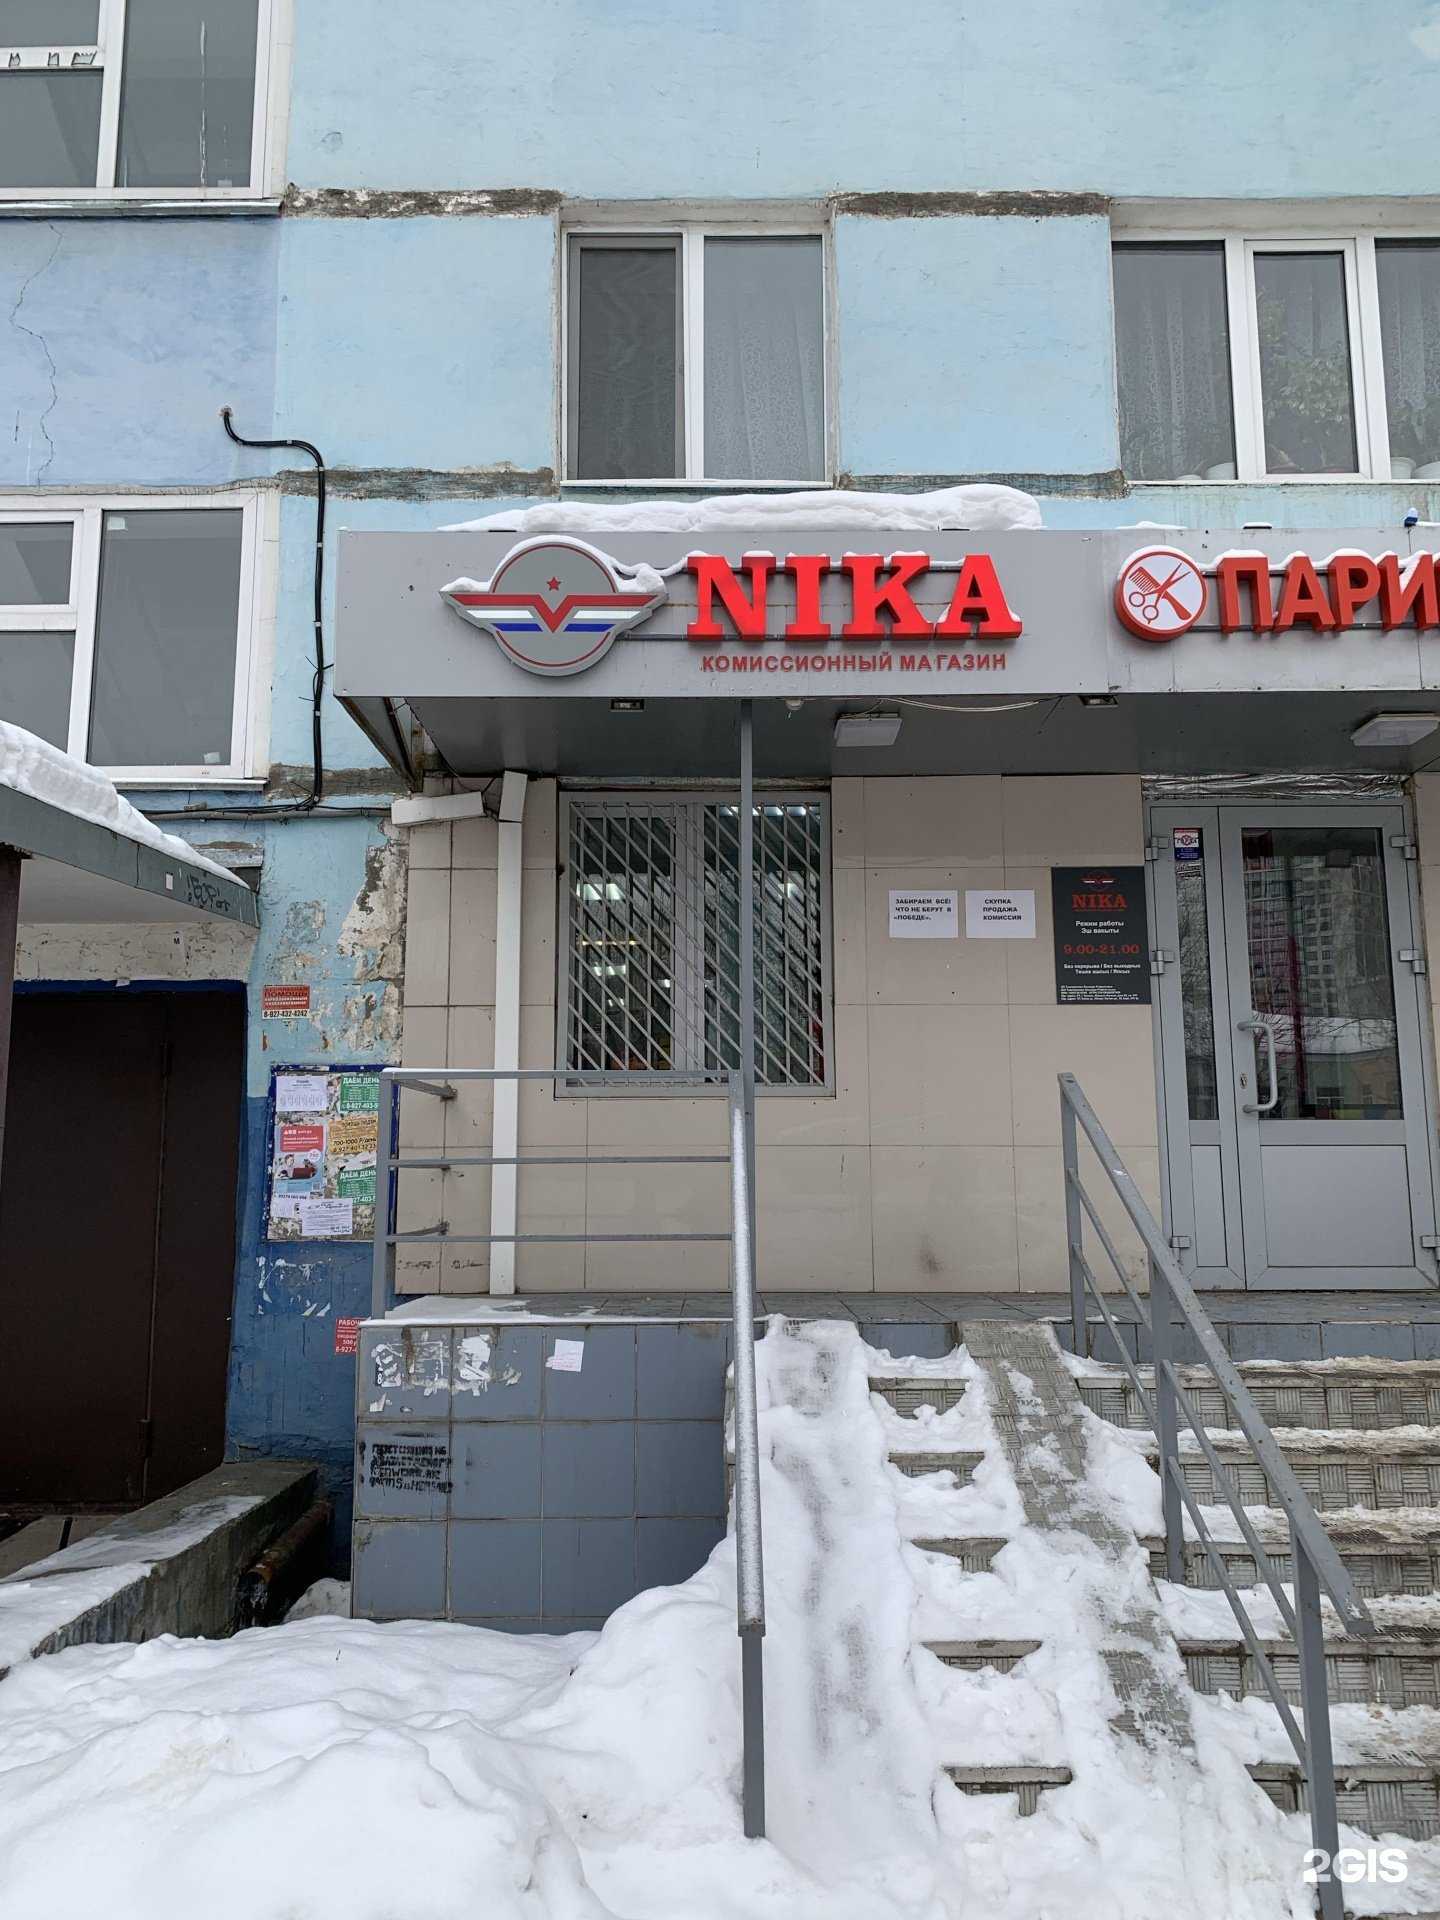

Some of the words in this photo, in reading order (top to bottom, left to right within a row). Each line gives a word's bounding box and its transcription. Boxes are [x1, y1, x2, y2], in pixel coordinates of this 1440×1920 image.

[687, 554, 1022, 641] NIKA
[1217, 554, 1440, 634] ПАРИ
[702, 652, 893, 672] КОМИССИОННЫЙ
[900, 653, 1006, 670] МАГАЗИН
[1071, 894, 1127, 908] NIKA
